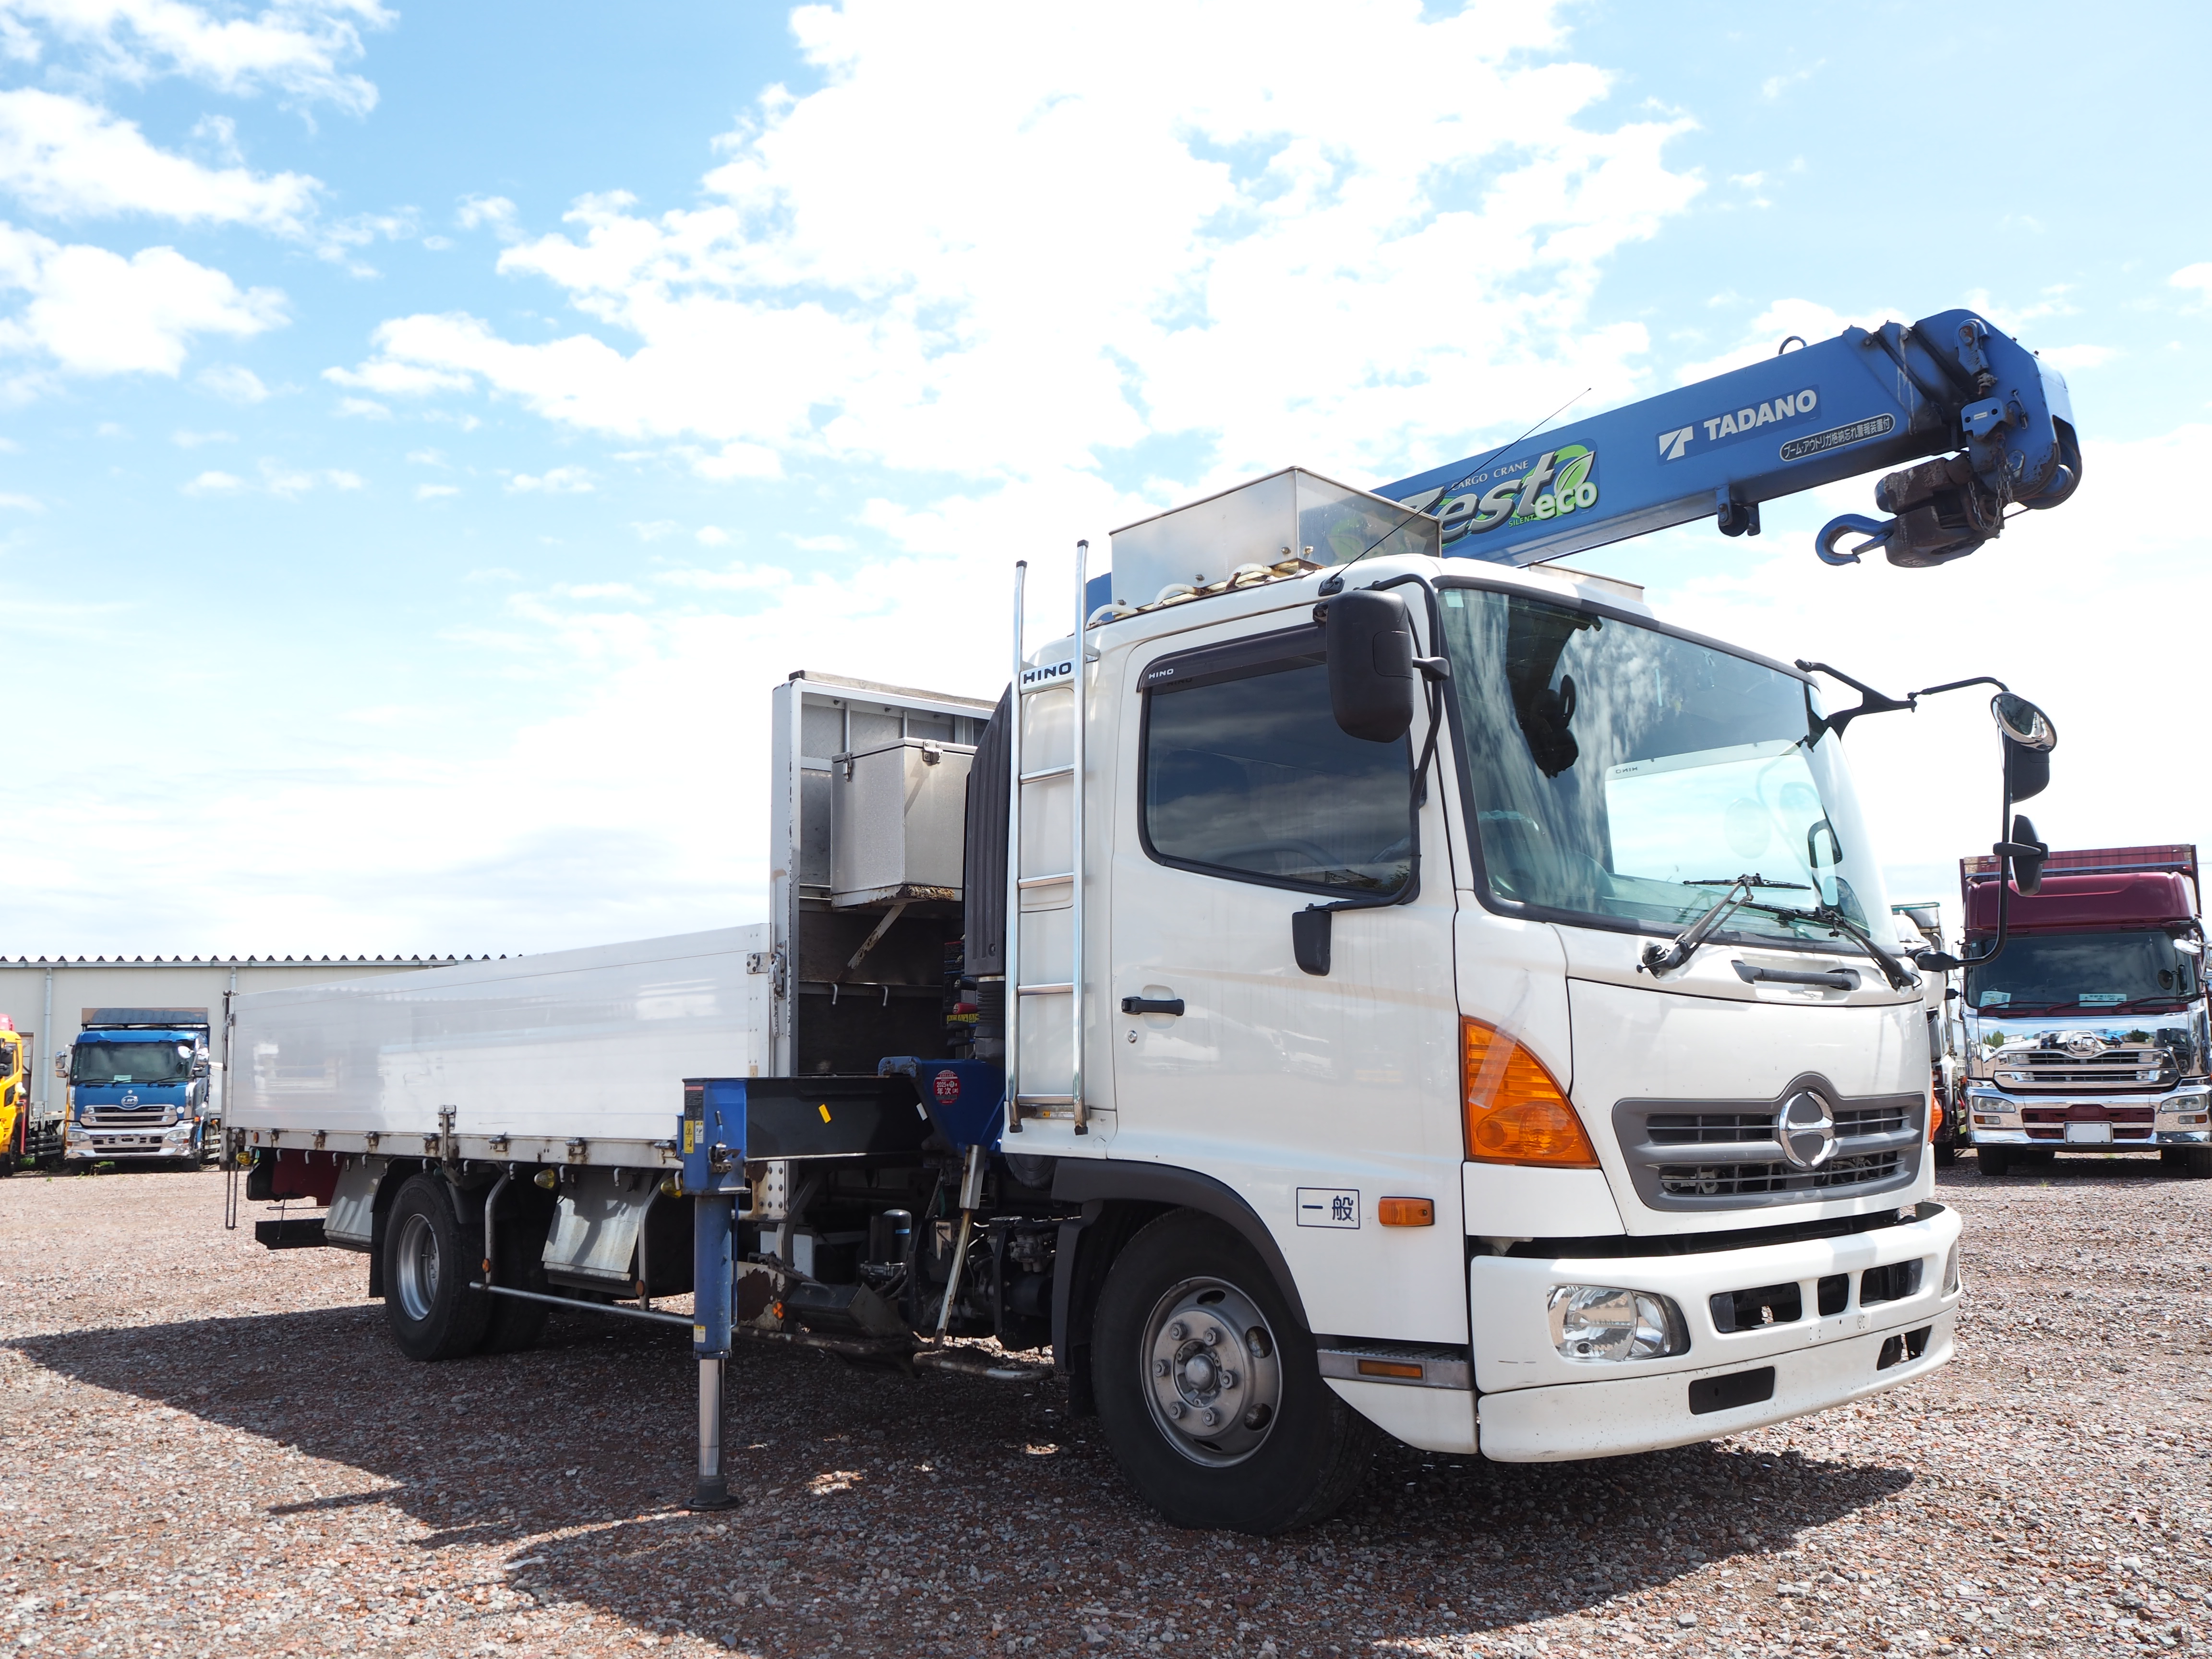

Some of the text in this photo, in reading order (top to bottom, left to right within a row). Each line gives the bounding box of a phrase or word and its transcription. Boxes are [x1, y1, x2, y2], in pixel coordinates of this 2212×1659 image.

[1704, 389, 1817, 441] TADANO
[1451, 460, 1528, 492] CARGO CRANE
[1534, 481, 1599, 520] eco
[1508, 515, 1535, 528] SILENT
[1023, 662, 1071, 684] HINO
[1148, 668, 1174, 680] HINO
[1302, 1195, 1355, 1222] 一般
